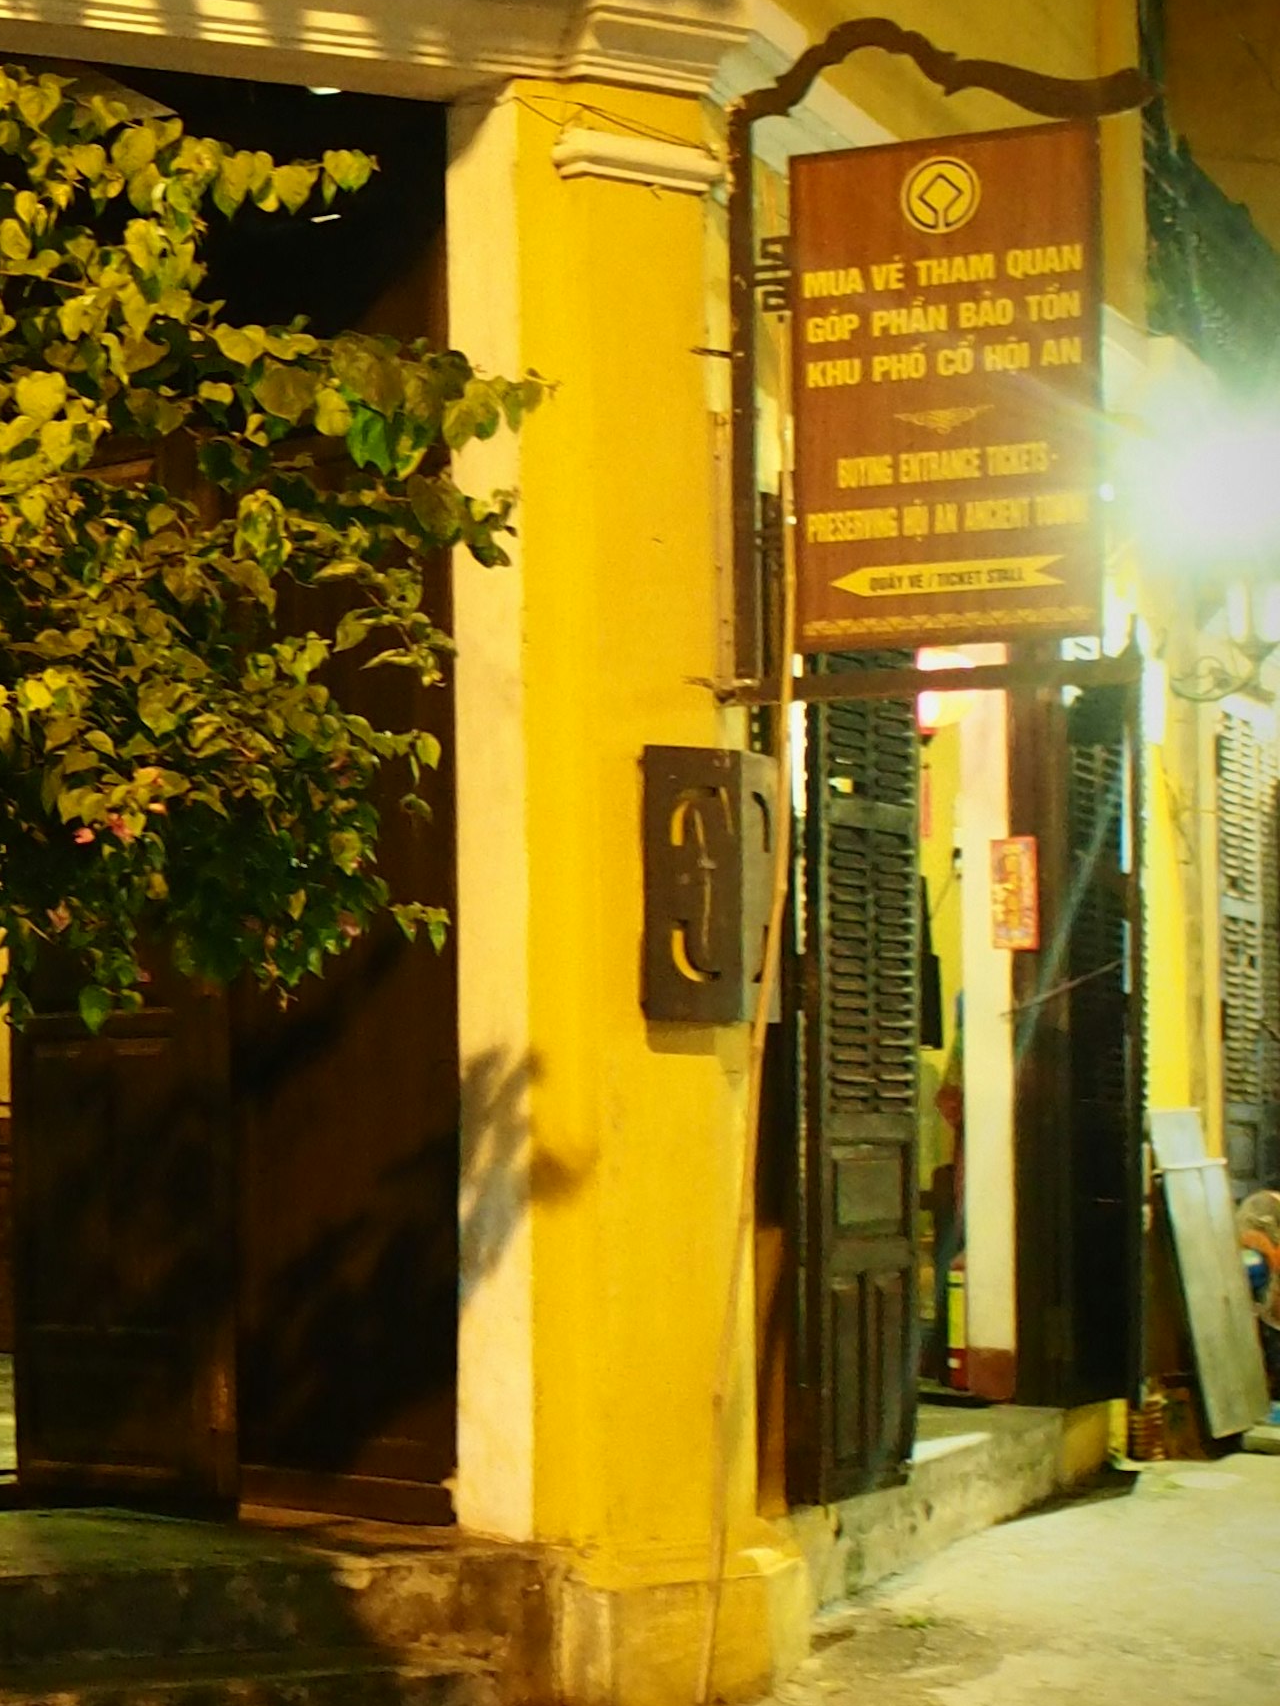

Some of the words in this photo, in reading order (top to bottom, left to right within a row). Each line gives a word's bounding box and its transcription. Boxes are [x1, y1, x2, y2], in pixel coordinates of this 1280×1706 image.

[802, 267, 865, 298] MUA
[914, 253, 996, 286] THAM
[1006, 243, 1083, 279] QUAN
[805, 309, 860, 344] GÓP
[805, 358, 862, 388] KHU
[871, 342, 927, 382] PHỐ
[983, 337, 1030, 376] HỘI
[1040, 337, 1082, 367] AN
[898, 447, 982, 484] ENTRANCE
[985, 441, 1049, 477] TICKETS
[938, 570, 982, 586] TICKET
[986, 567, 1025, 583] STALL
